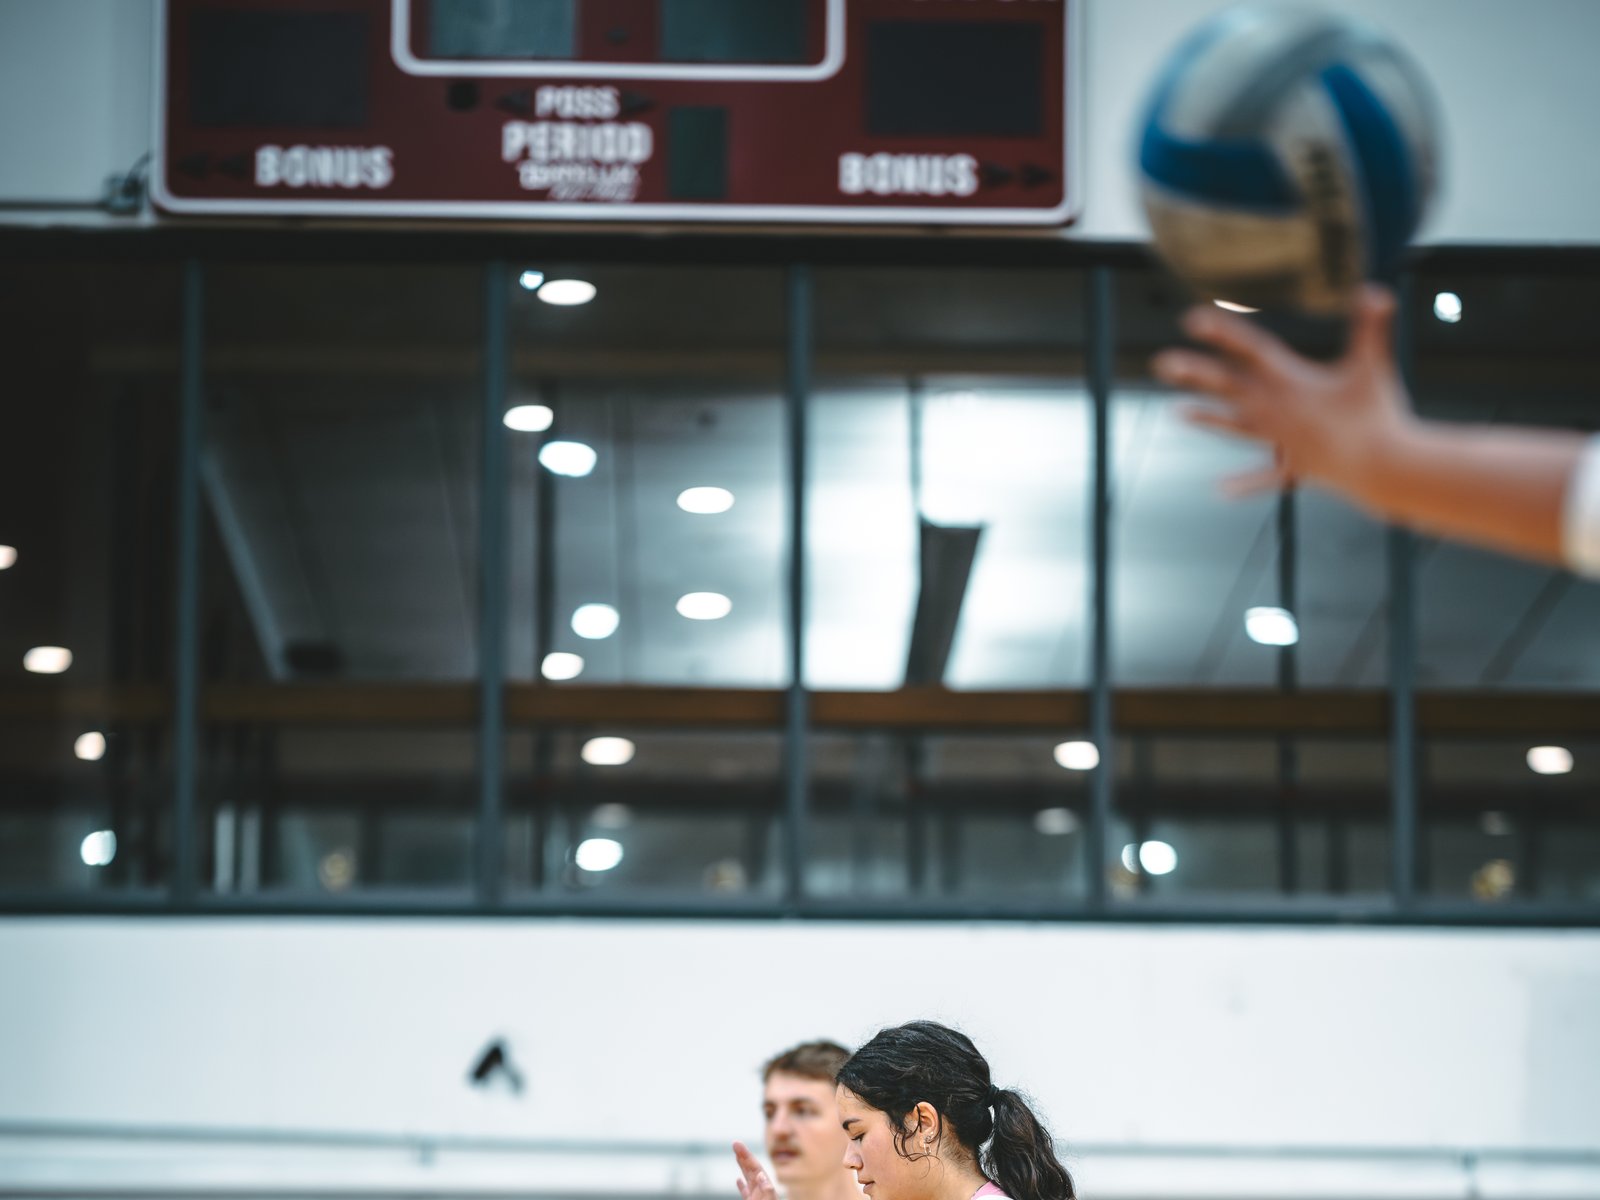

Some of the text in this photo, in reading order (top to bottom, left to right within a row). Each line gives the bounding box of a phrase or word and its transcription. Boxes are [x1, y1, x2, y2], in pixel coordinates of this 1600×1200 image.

[536, 86, 620, 119] POSS
[502, 121, 653, 163] PERIOD
[254, 146, 394, 189] BONUS
[838, 152, 979, 197] BONUS
